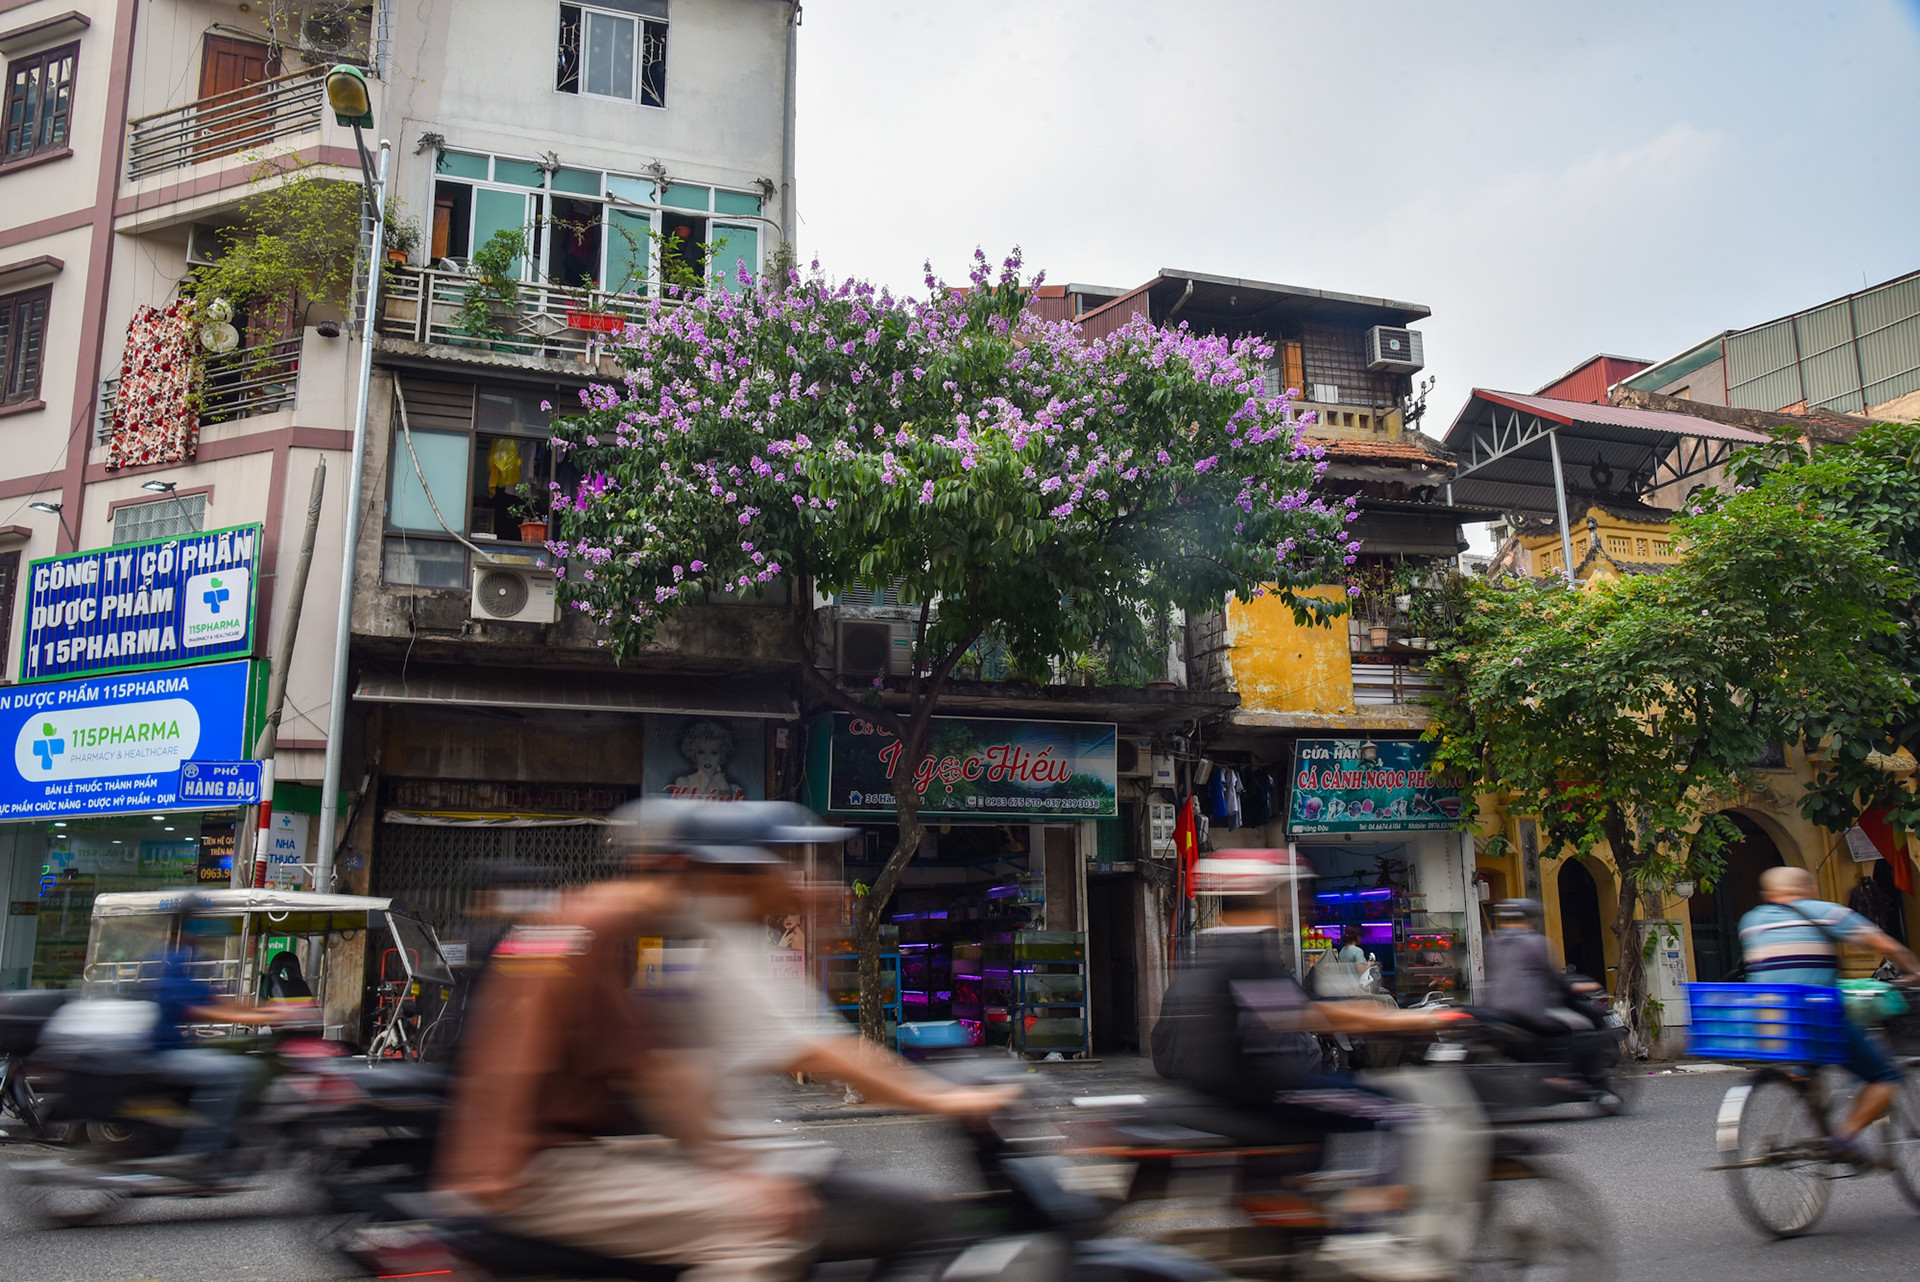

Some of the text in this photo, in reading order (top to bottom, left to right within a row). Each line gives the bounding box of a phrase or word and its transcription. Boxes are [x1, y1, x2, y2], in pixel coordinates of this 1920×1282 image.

[34, 531, 252, 593] CÔNG TY CỔ PHẦN
[31, 578, 175, 631] DƯỢC PHẨM
[188, 618, 240, 635] 115PHARMA
[29, 626, 177, 668] 115PHARMA
[14, 691, 55, 709] DƯỢC
[58, 683, 100, 704] PHẨM
[103, 677, 189, 700] 115PHARMA
[72, 720, 180, 748] 115PHARMA
[849, 718, 875, 736] Cá
[70, 746, 179, 763] PHARMACY & HEALTHCARE
[1302, 745, 1361, 760] CỬA HÀN
[213, 764, 239, 776] PHỐ
[986, 744, 1073, 784] Hiếu
[45, 781, 62, 796] BÁN
[75, 779, 103, 793] THUỐC
[104, 778, 132, 791] THÀNH
[134, 774, 158, 788] PHẨM
[1297, 766, 1318, 790] CÁ
[1321, 763, 1363, 790] CẢNH
[1365, 769, 1405, 793] NGỌC
[185, 778, 255, 799] HÀNG ĐẬU
[865, 793, 878, 804] 36
[11, 799, 33, 813] PHẨM
[34, 799, 57, 811] CHỨC
[58, 798, 81, 810] NĂNG
[88, 798, 111, 809] DƯỢC
[112, 795, 125, 806] MỸ
[126, 794, 150, 805] PHẨM
[157, 793, 176, 805] DỤN
[985, 797, 1008, 807] 0983
[1008, 797, 1025, 808] 675
[1061, 799, 1078, 809] 299
[1079, 799, 1100, 809] 3038
[226, 834, 235, 845] QU
[276, 838, 295, 849] NHÀ
